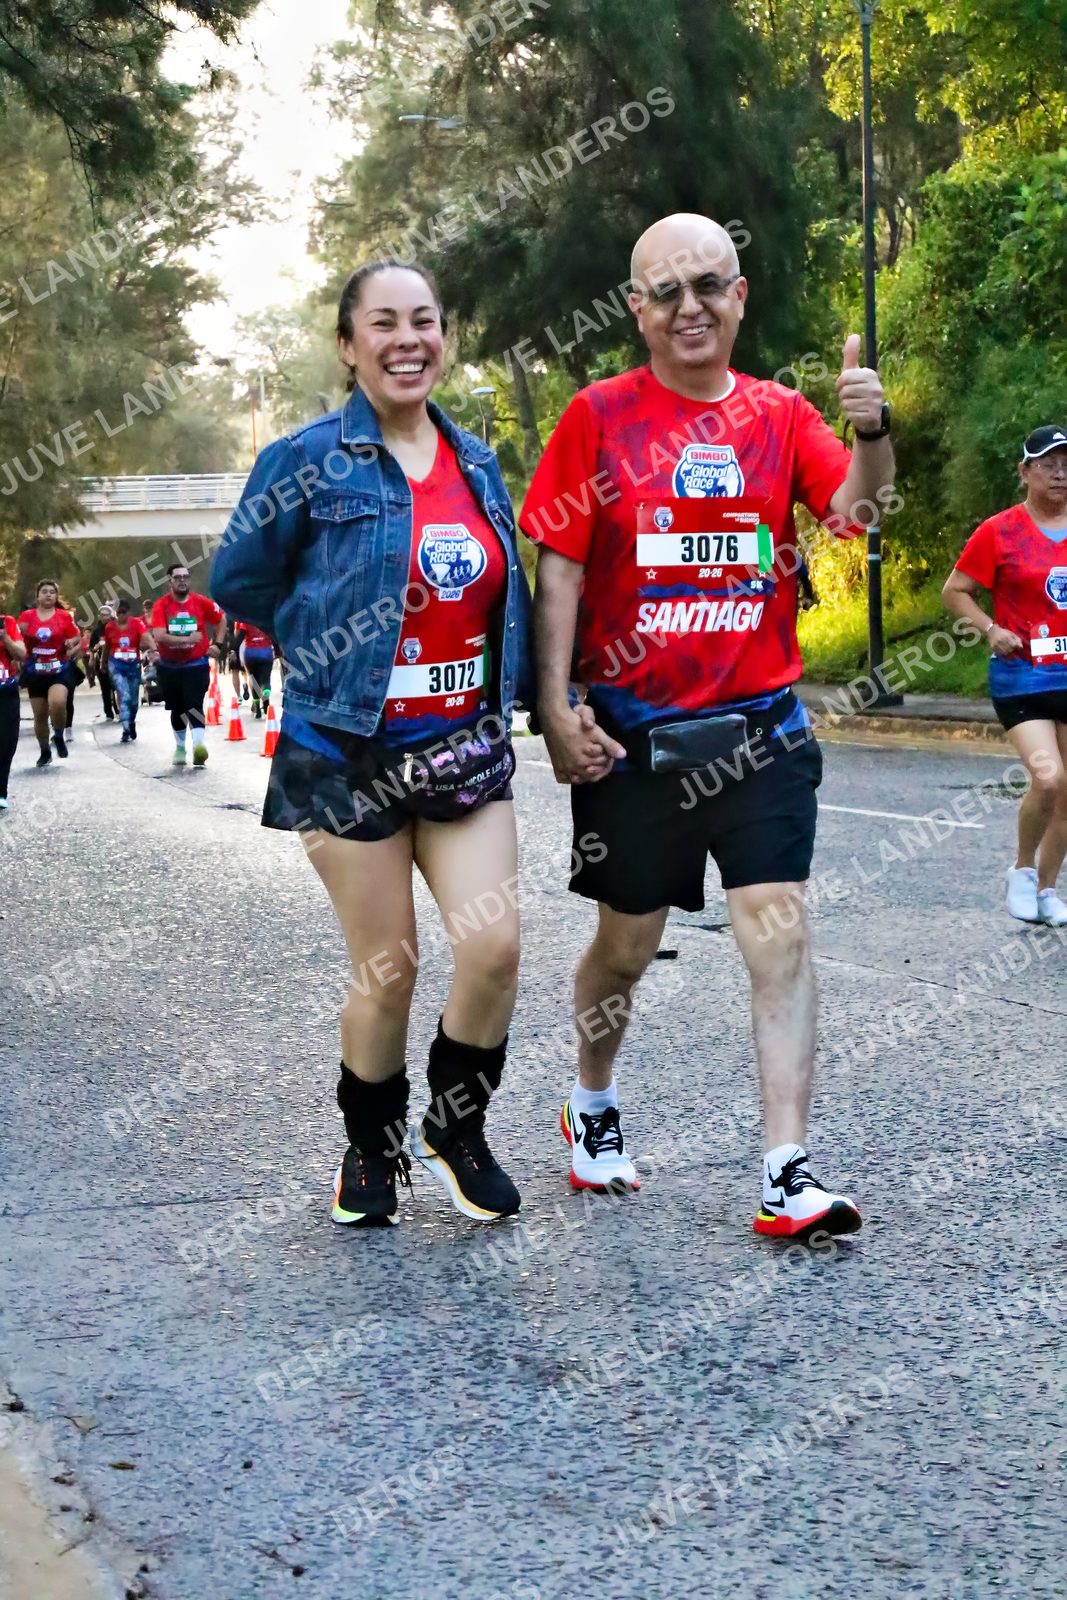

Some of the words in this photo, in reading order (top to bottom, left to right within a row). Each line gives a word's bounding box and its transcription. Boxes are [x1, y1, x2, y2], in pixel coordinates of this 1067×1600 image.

[690, 452, 728, 461] BIMBO
[691, 465, 728, 478] Global
[684, 476, 715, 489] Race
[430, 530, 464, 538] BIMBO
[434, 540, 467, 552] Global
[680, 534, 739, 563] 3076
[429, 551, 457, 564] Race
[635, 601, 764, 633] SANTIAGO
[428, 660, 475, 694] 3072
[435, 783, 455, 791] USA
[464, 768, 491, 788] NICOLE
